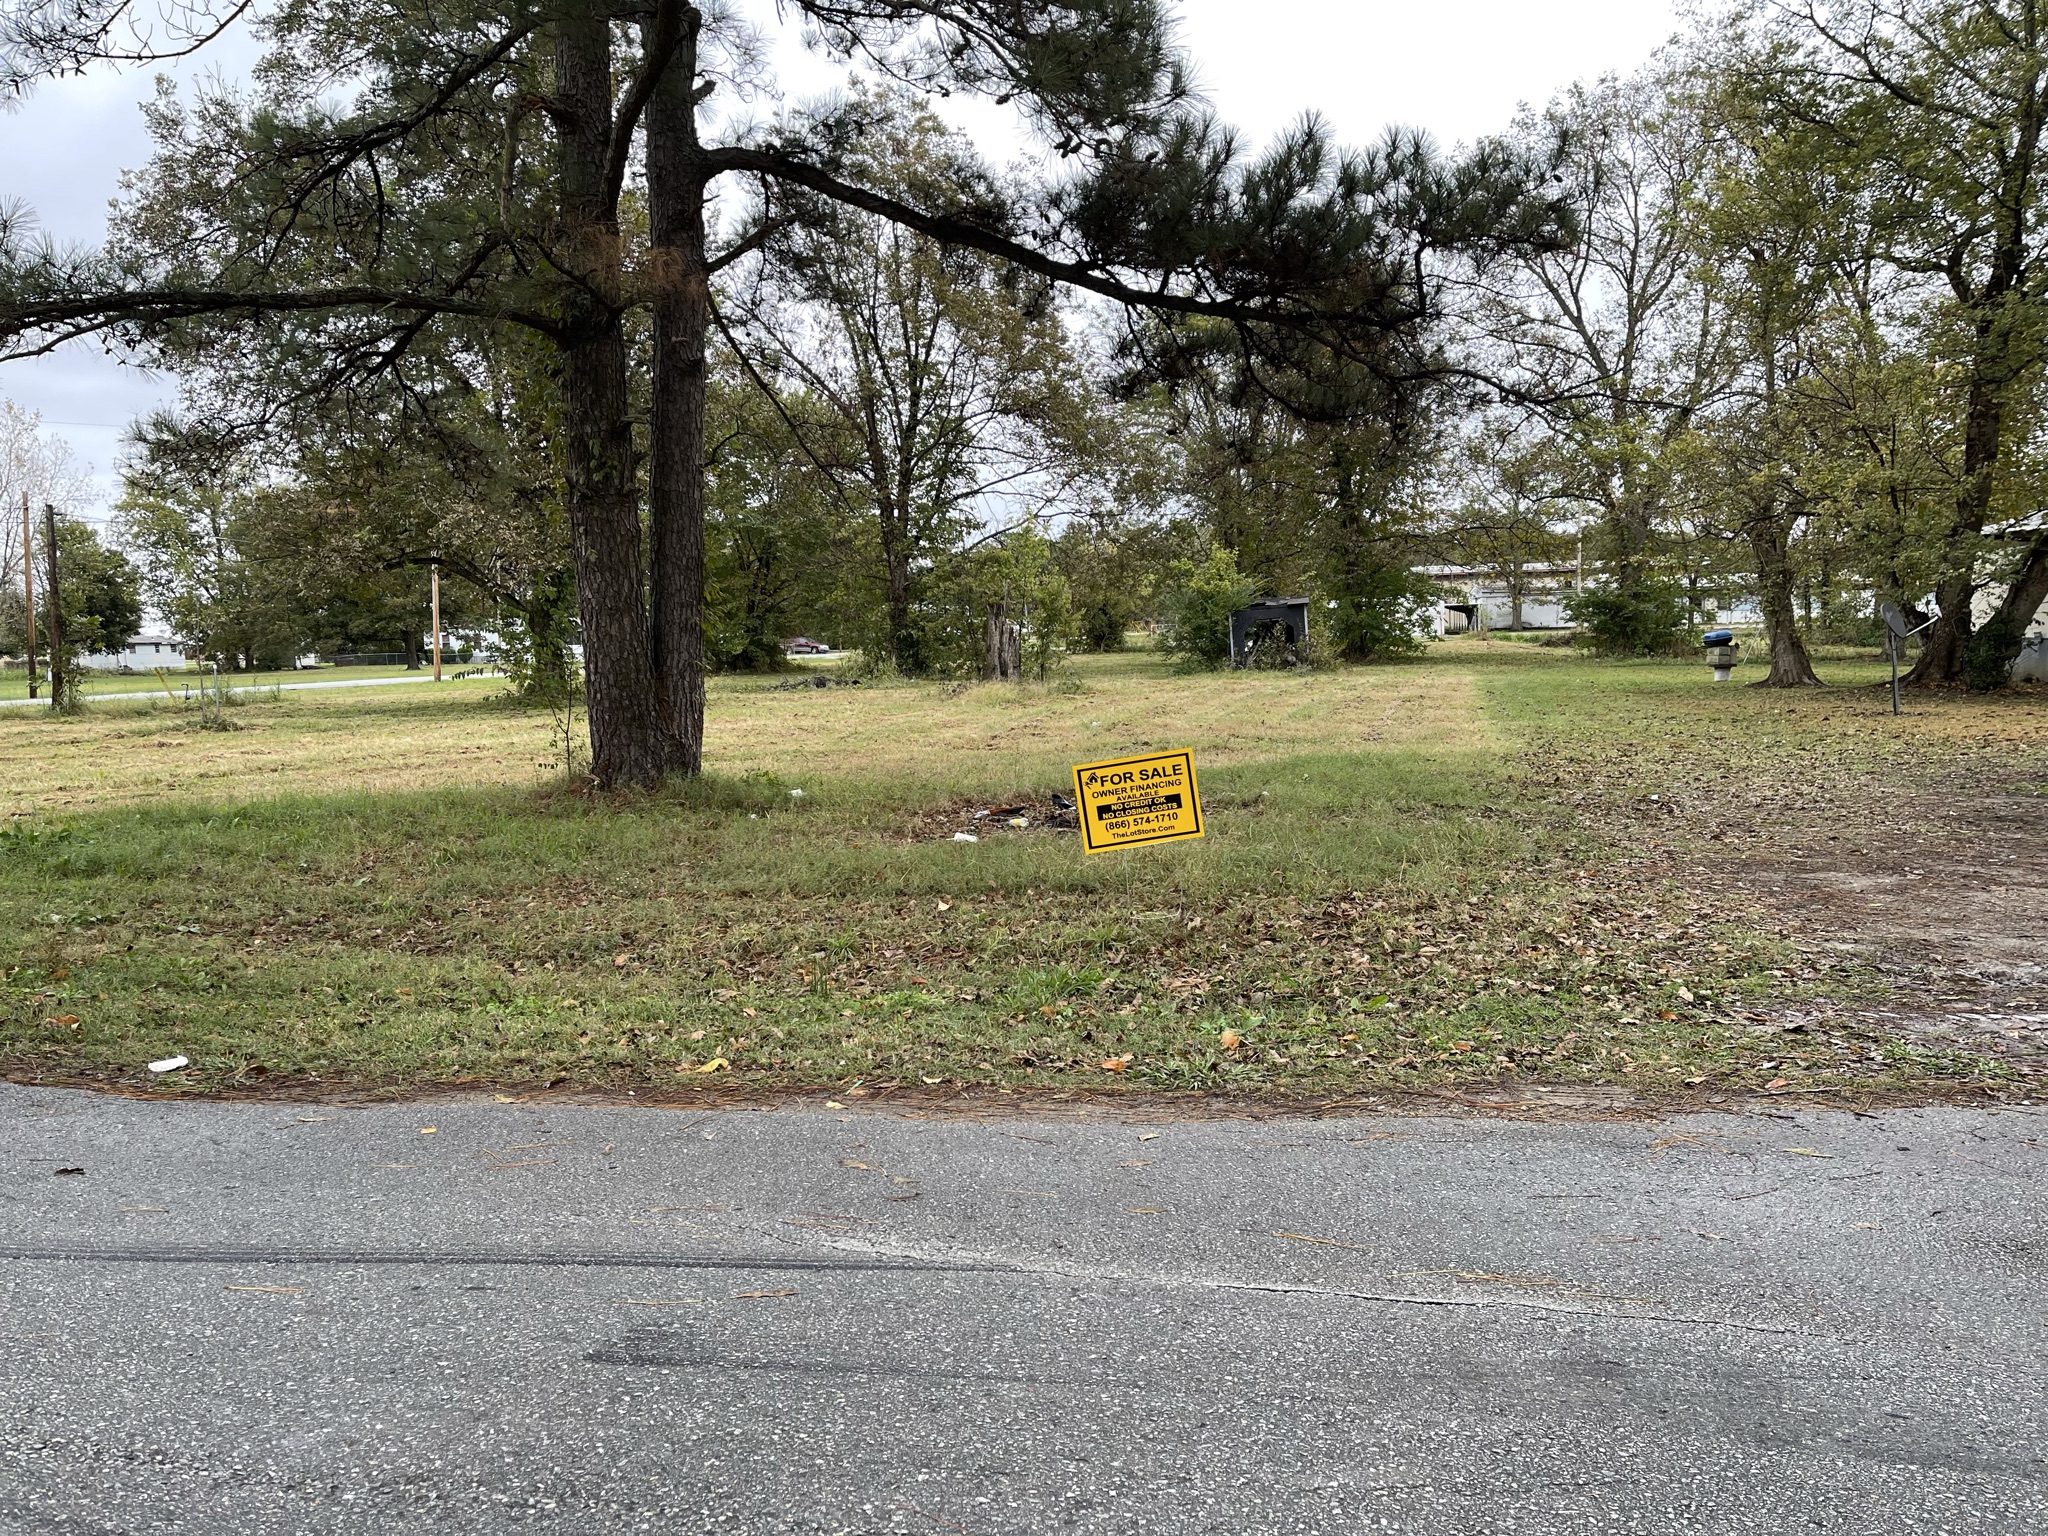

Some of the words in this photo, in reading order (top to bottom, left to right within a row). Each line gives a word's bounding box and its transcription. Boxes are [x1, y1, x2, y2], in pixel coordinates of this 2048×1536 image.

[1100, 772, 1134, 787] FOR
[1139, 764, 1183, 781] SALE
[1092, 787, 1127, 798] OWNER
[1130, 779, 1182, 792] FINANCING
[1117, 790, 1159, 801] AVAILABLE
[1116, 807, 1150, 818] CLOSING
[1152, 803, 1177, 812] COSTS
[1125, 799, 1152, 809] CREDIT
[1105, 820, 1130, 832] (866)
[1133, 812, 1178, 826] 574-1710
[1112, 825, 1175, 839] TheLotStore.Com
